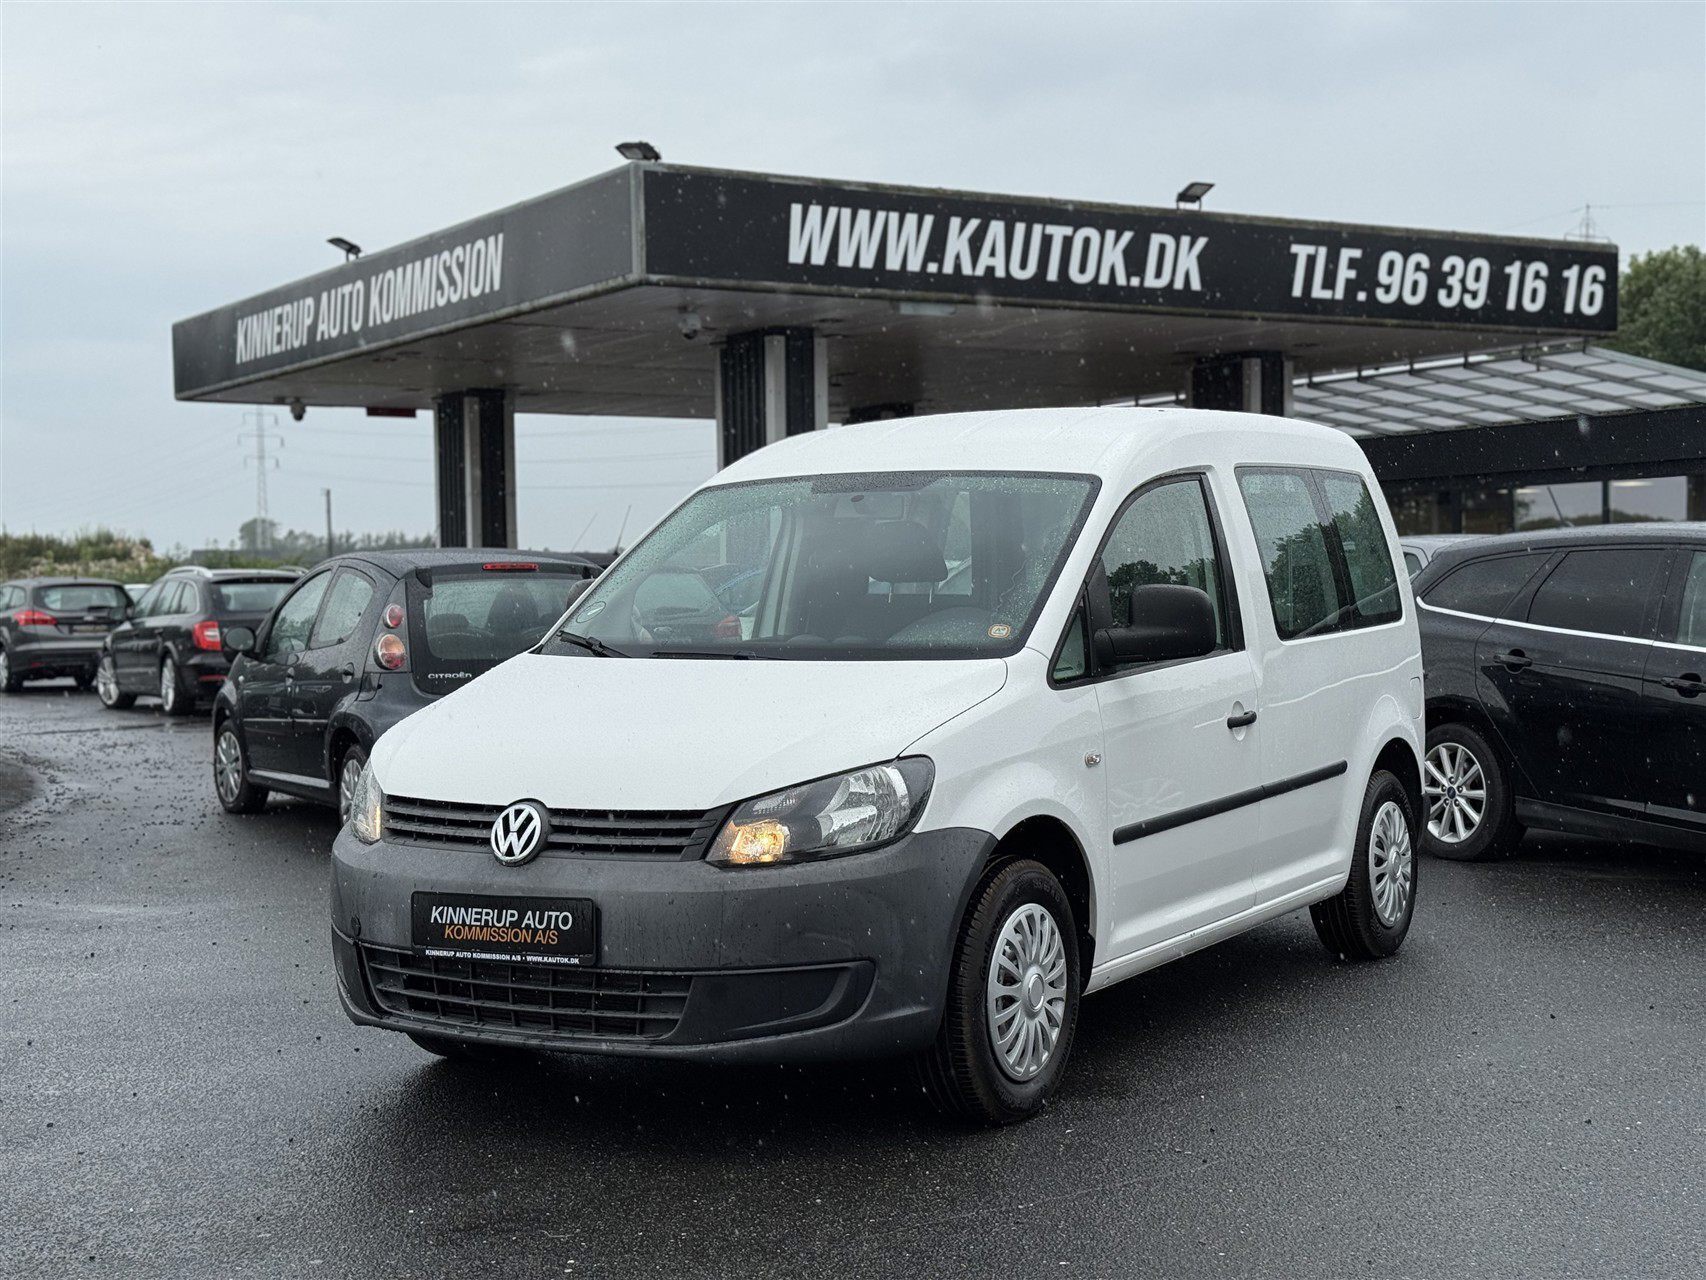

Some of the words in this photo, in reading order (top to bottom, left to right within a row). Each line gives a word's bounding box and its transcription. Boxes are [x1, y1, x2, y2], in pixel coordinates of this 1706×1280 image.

[787, 202, 1209, 292] WWW.KAUTOK.DK
[236, 296, 315, 365] KINNERUP
[316, 279, 365, 342] AUTO
[368, 232, 504, 328] KOMMISSION
[1290, 243, 1367, 301] TLF.
[1375, 250, 1431, 306] 96
[1437, 255, 1491, 310] 39
[1504, 260, 1549, 313] 16
[1562, 264, 1607, 317] 16
[492, 805, 541, 861] VW
[430, 905, 519, 928] KINNERUP
[521, 910, 573, 931] AUTO
[444, 924, 532, 944] KOMMISSION
[534, 928, 559, 945] A/S
[425, 949, 455, 957] KINNERUP
[456, 951, 472, 959] AUTO
[472, 952, 511, 961] KOMMISSION
[511, 954, 522, 962] A/S
[526, 955, 580, 965] WWW.KAUTOK.DK
